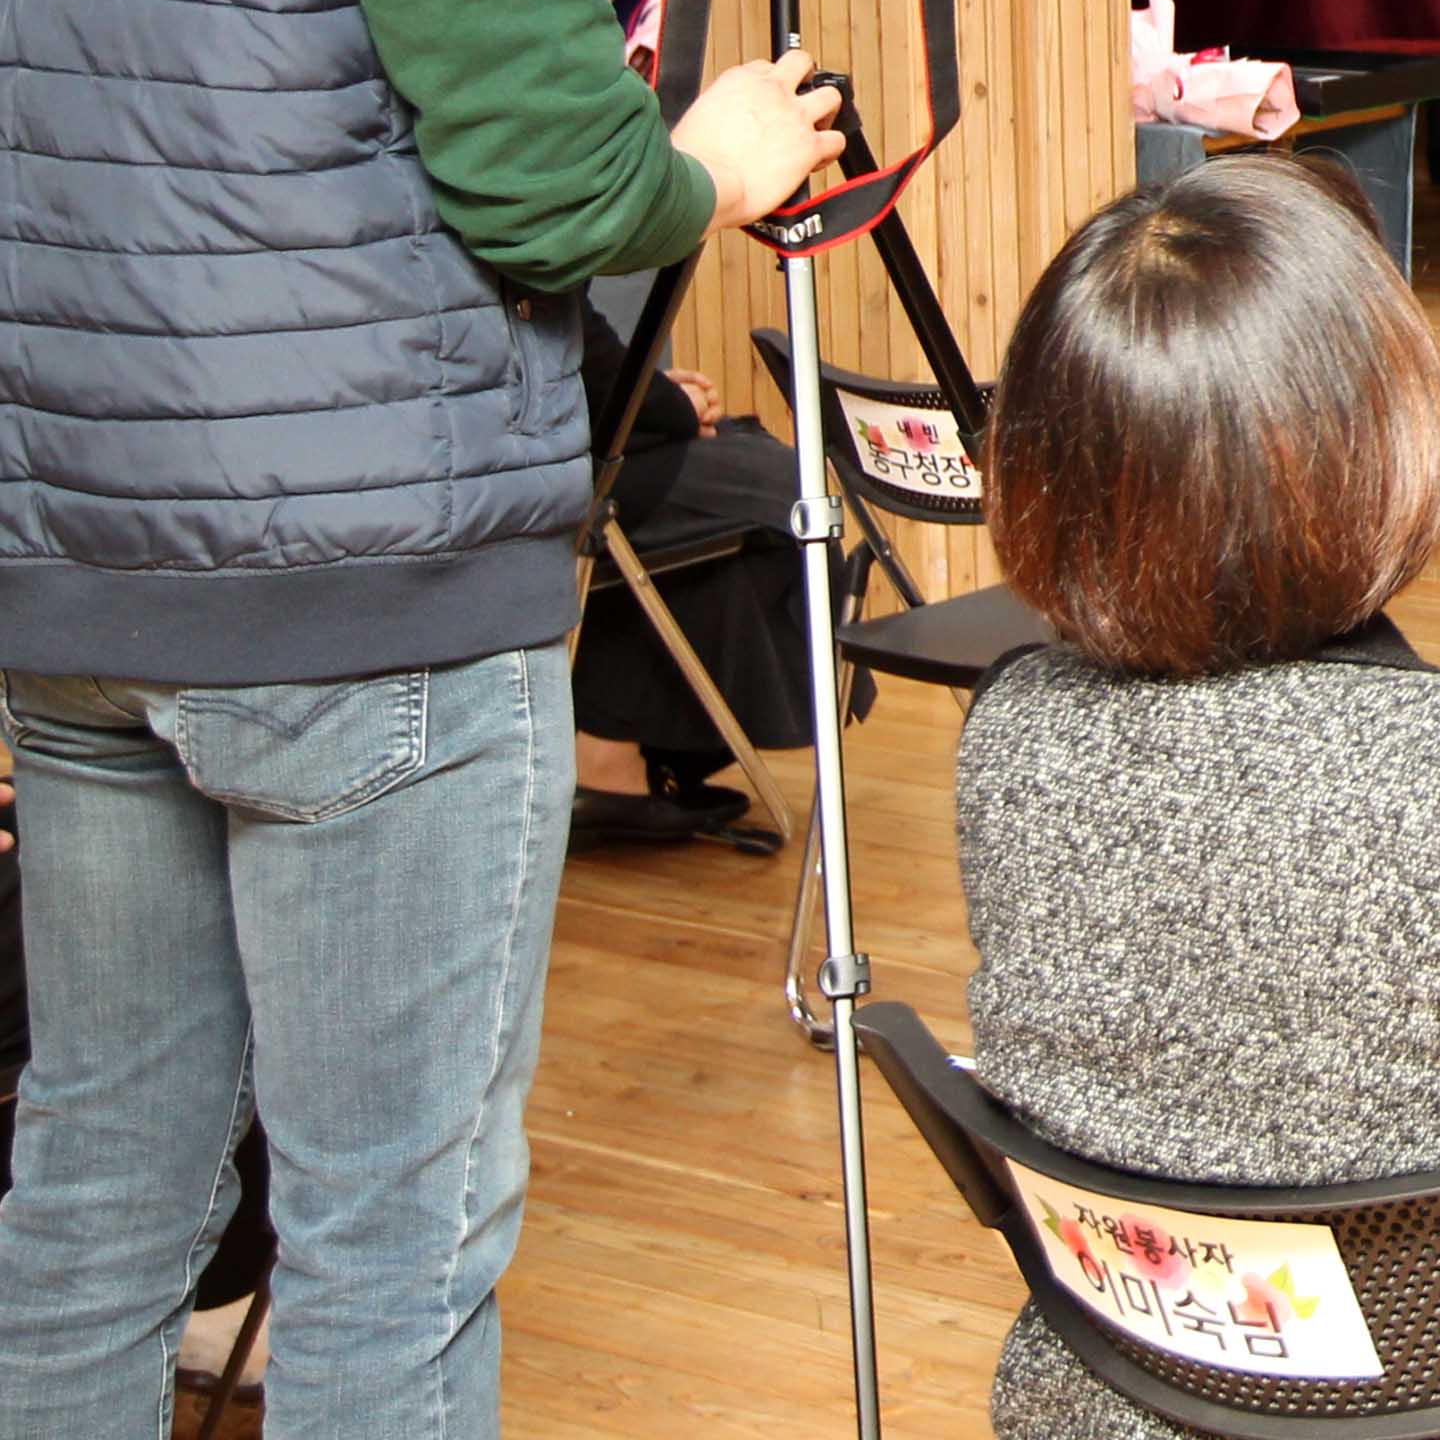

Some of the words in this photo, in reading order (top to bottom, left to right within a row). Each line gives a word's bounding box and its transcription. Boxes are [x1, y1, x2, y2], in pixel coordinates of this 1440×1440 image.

[753, 213, 823, 244] anon
[868, 440, 972, 488] 동구청장
[1072, 1202, 1236, 1275] 자원봉사자
[1076, 1250, 1289, 1358] 이미숙님
